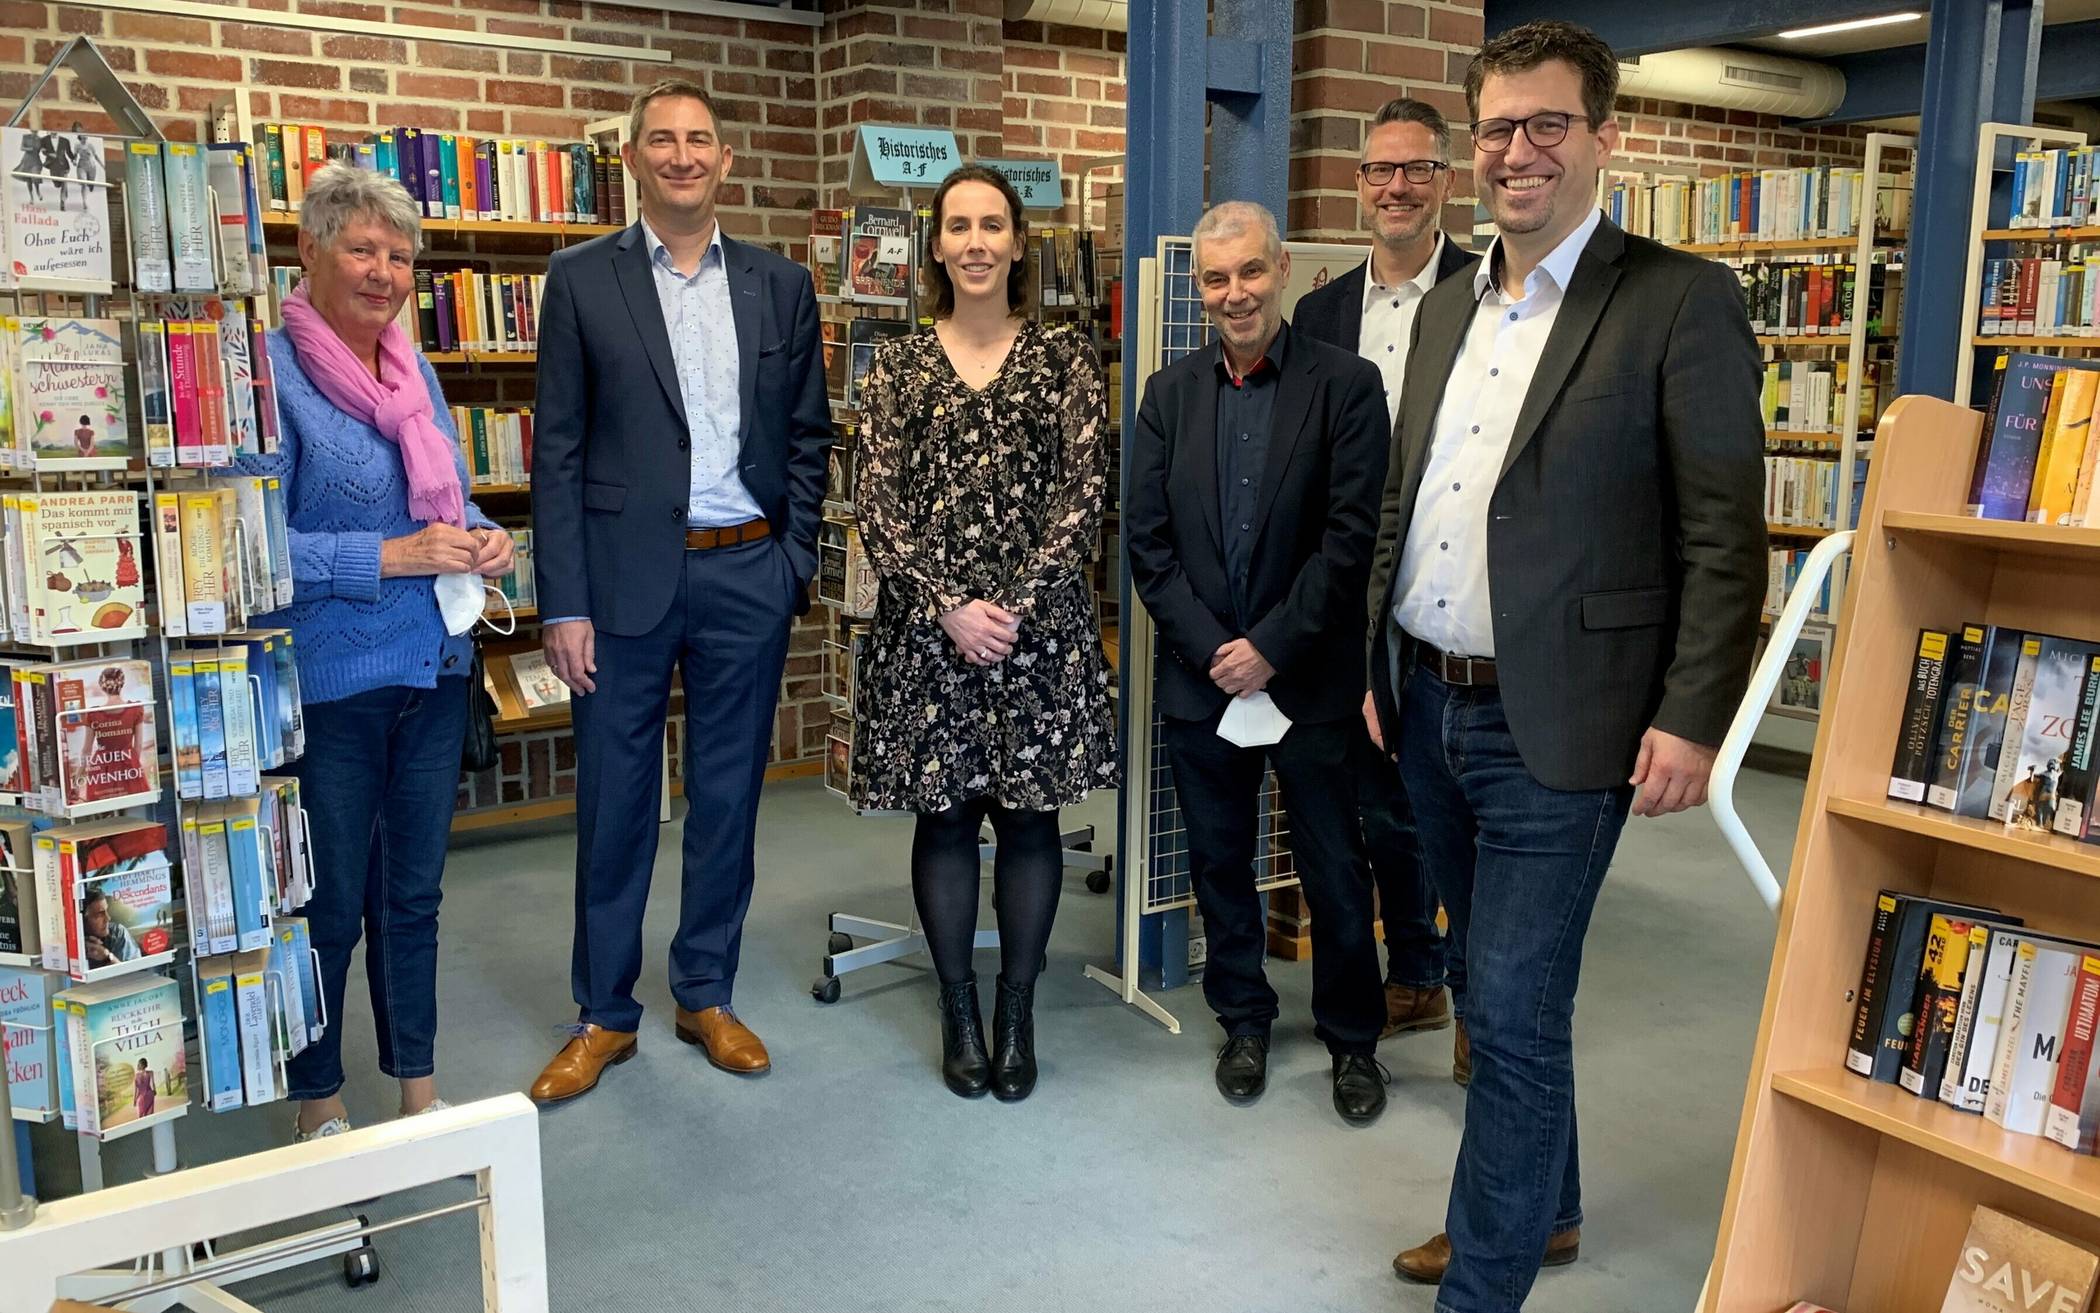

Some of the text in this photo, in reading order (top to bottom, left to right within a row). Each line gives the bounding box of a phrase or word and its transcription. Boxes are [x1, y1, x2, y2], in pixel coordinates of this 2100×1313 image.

[877, 137, 947, 163] Historisches
[22, 203, 48, 213] Hans
[14, 213, 59, 226] Fallada
[861, 221, 905, 237] Cornwell
[868, 214, 900, 226] Bernard
[24, 228, 90, 247] Ohne Euch
[60, 241, 103, 256] wäre ich
[887, 247, 903, 255] A-F
[173, 344, 185, 380] Stunde
[2006, 413, 2037, 431] FÜR
[40, 495, 134, 506] ANDREA PARR
[41, 505, 134, 518] Das kommt mir
[41, 519, 117, 531] spanisch vor
[1917, 659, 1931, 679] BUCH
[1947, 687, 1972, 771] CARRIER
[2071, 672, 2100, 769] JAMES LEE BURK
[1929, 934, 1942, 963] 42
[1866, 937, 1884, 984] ELYSIUM
[1863, 987, 1872, 1002] IM
[2012, 1004, 2022, 1021] THE
[2074, 978, 2100, 1041] ULTIMATUM
[1855, 1008, 1870, 1041] FEUER
[10, 1028, 35, 1048] am
[115, 1032, 163, 1052] VILLA
[2032, 1033, 2062, 1062] M
[1959, 1246, 2081, 1313] SAVE
